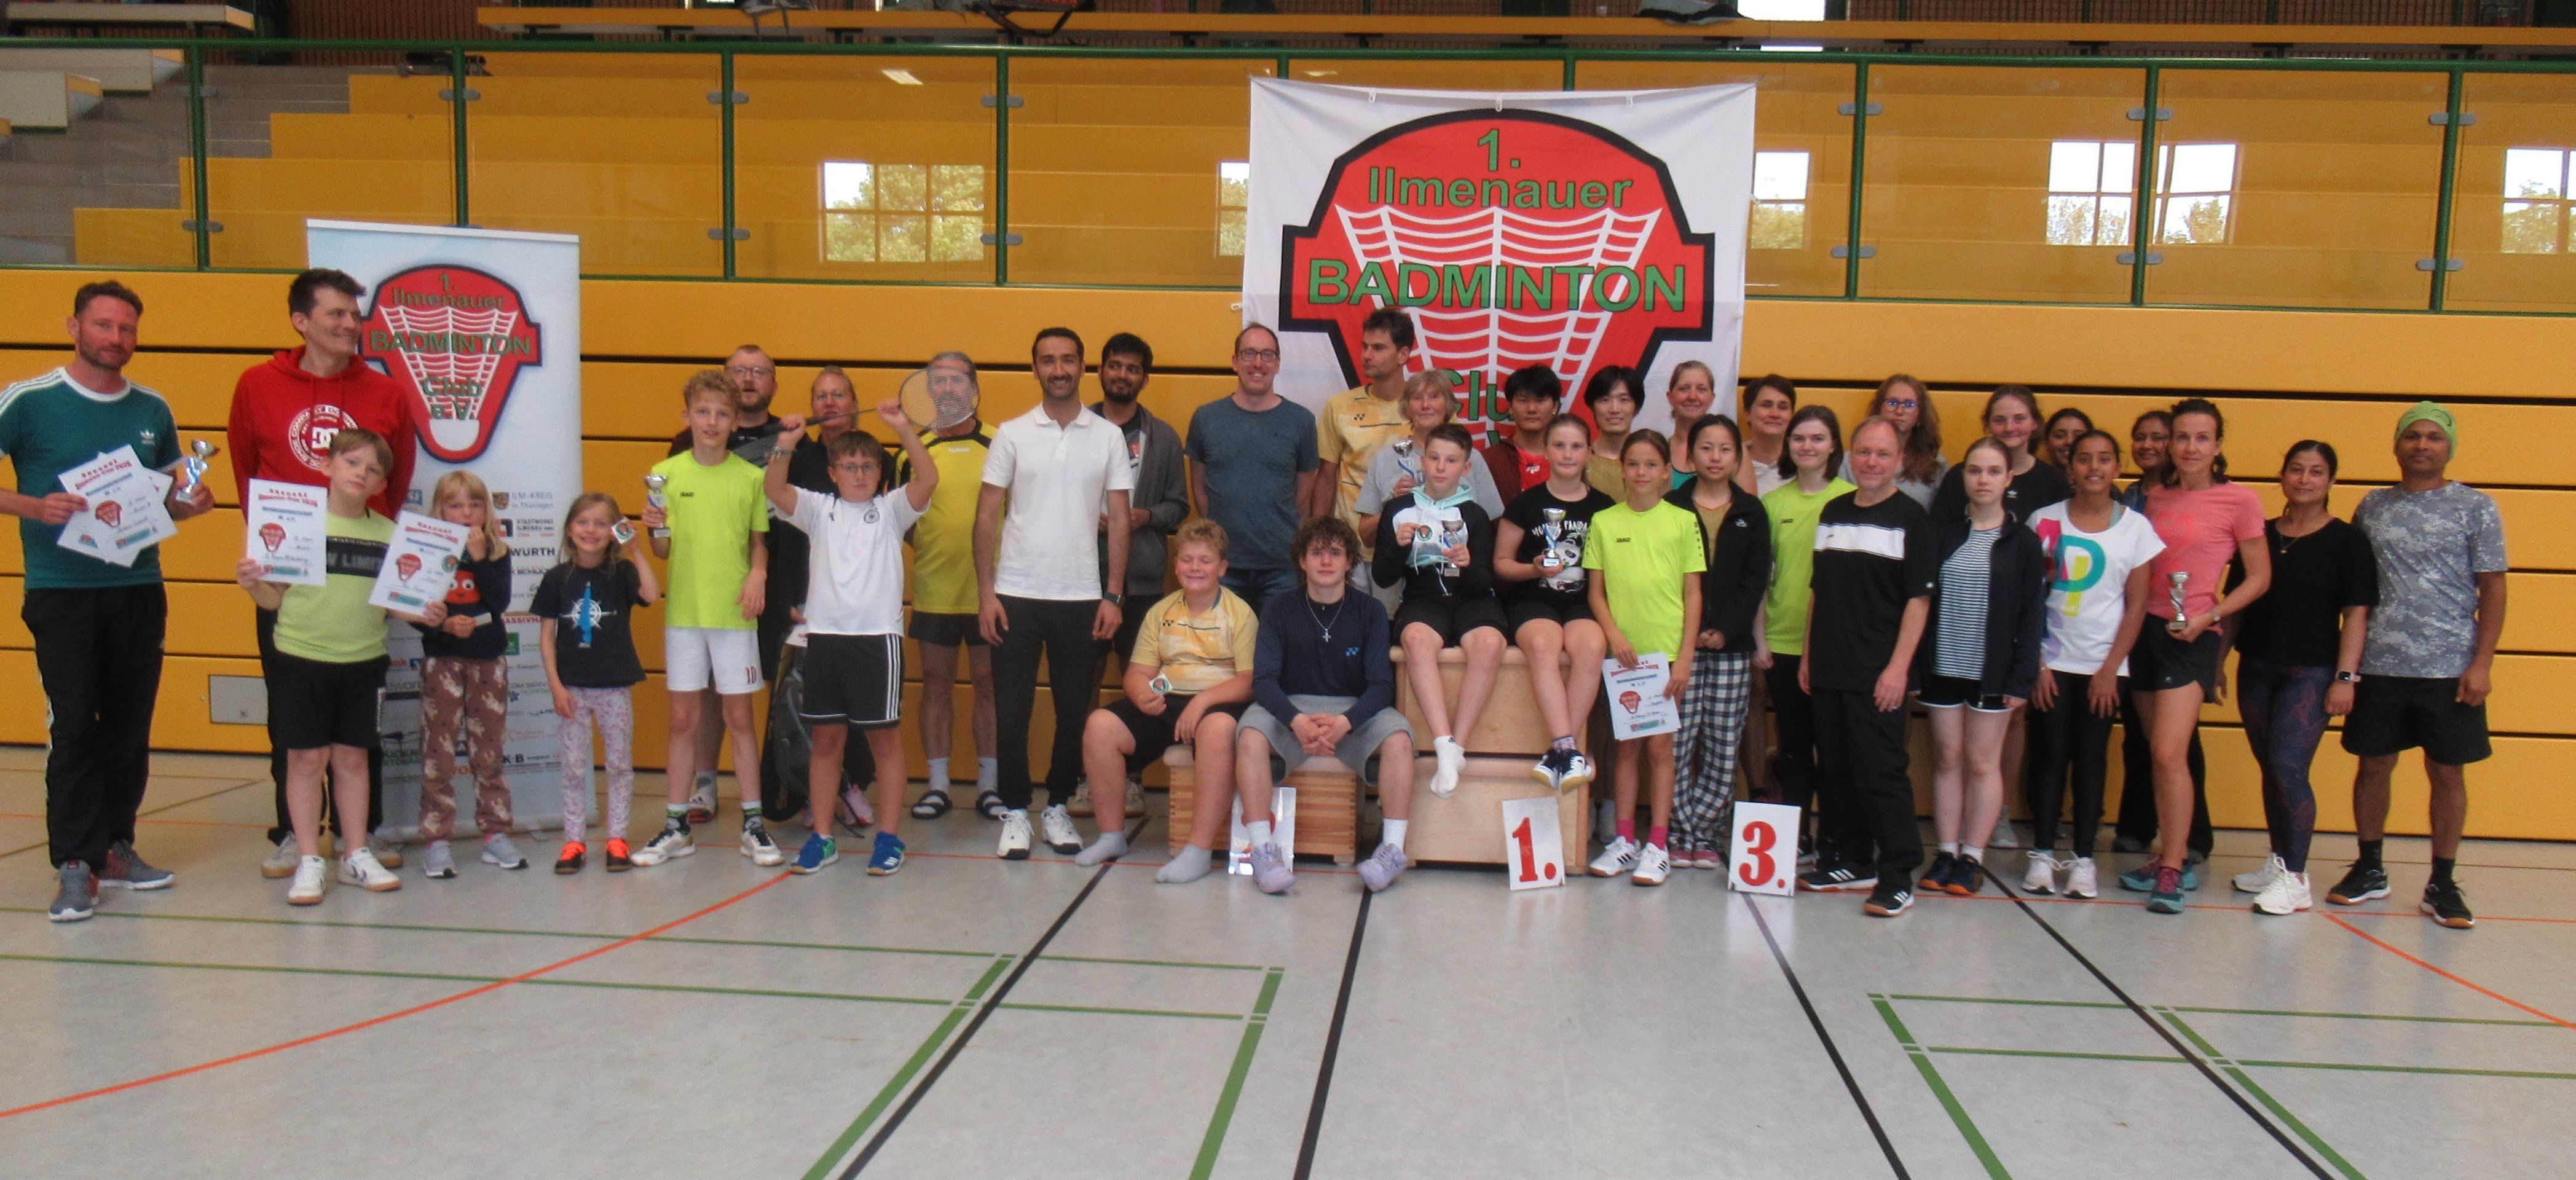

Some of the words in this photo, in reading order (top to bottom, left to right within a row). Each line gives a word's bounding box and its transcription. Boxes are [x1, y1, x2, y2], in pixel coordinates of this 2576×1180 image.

[1478, 129, 1521, 172] 1.
[1369, 167, 1634, 209] Ilmenauer
[392, 288, 506, 308] Ilmenauer
[439, 273, 459, 292] 1.
[1308, 259, 1685, 313] BADMINTON
[370, 330, 531, 355] BADMINTON
[422, 377, 483, 397] Club
[1511, 817, 1557, 882] 1.
[1738, 820, 1786, 889] 3.
